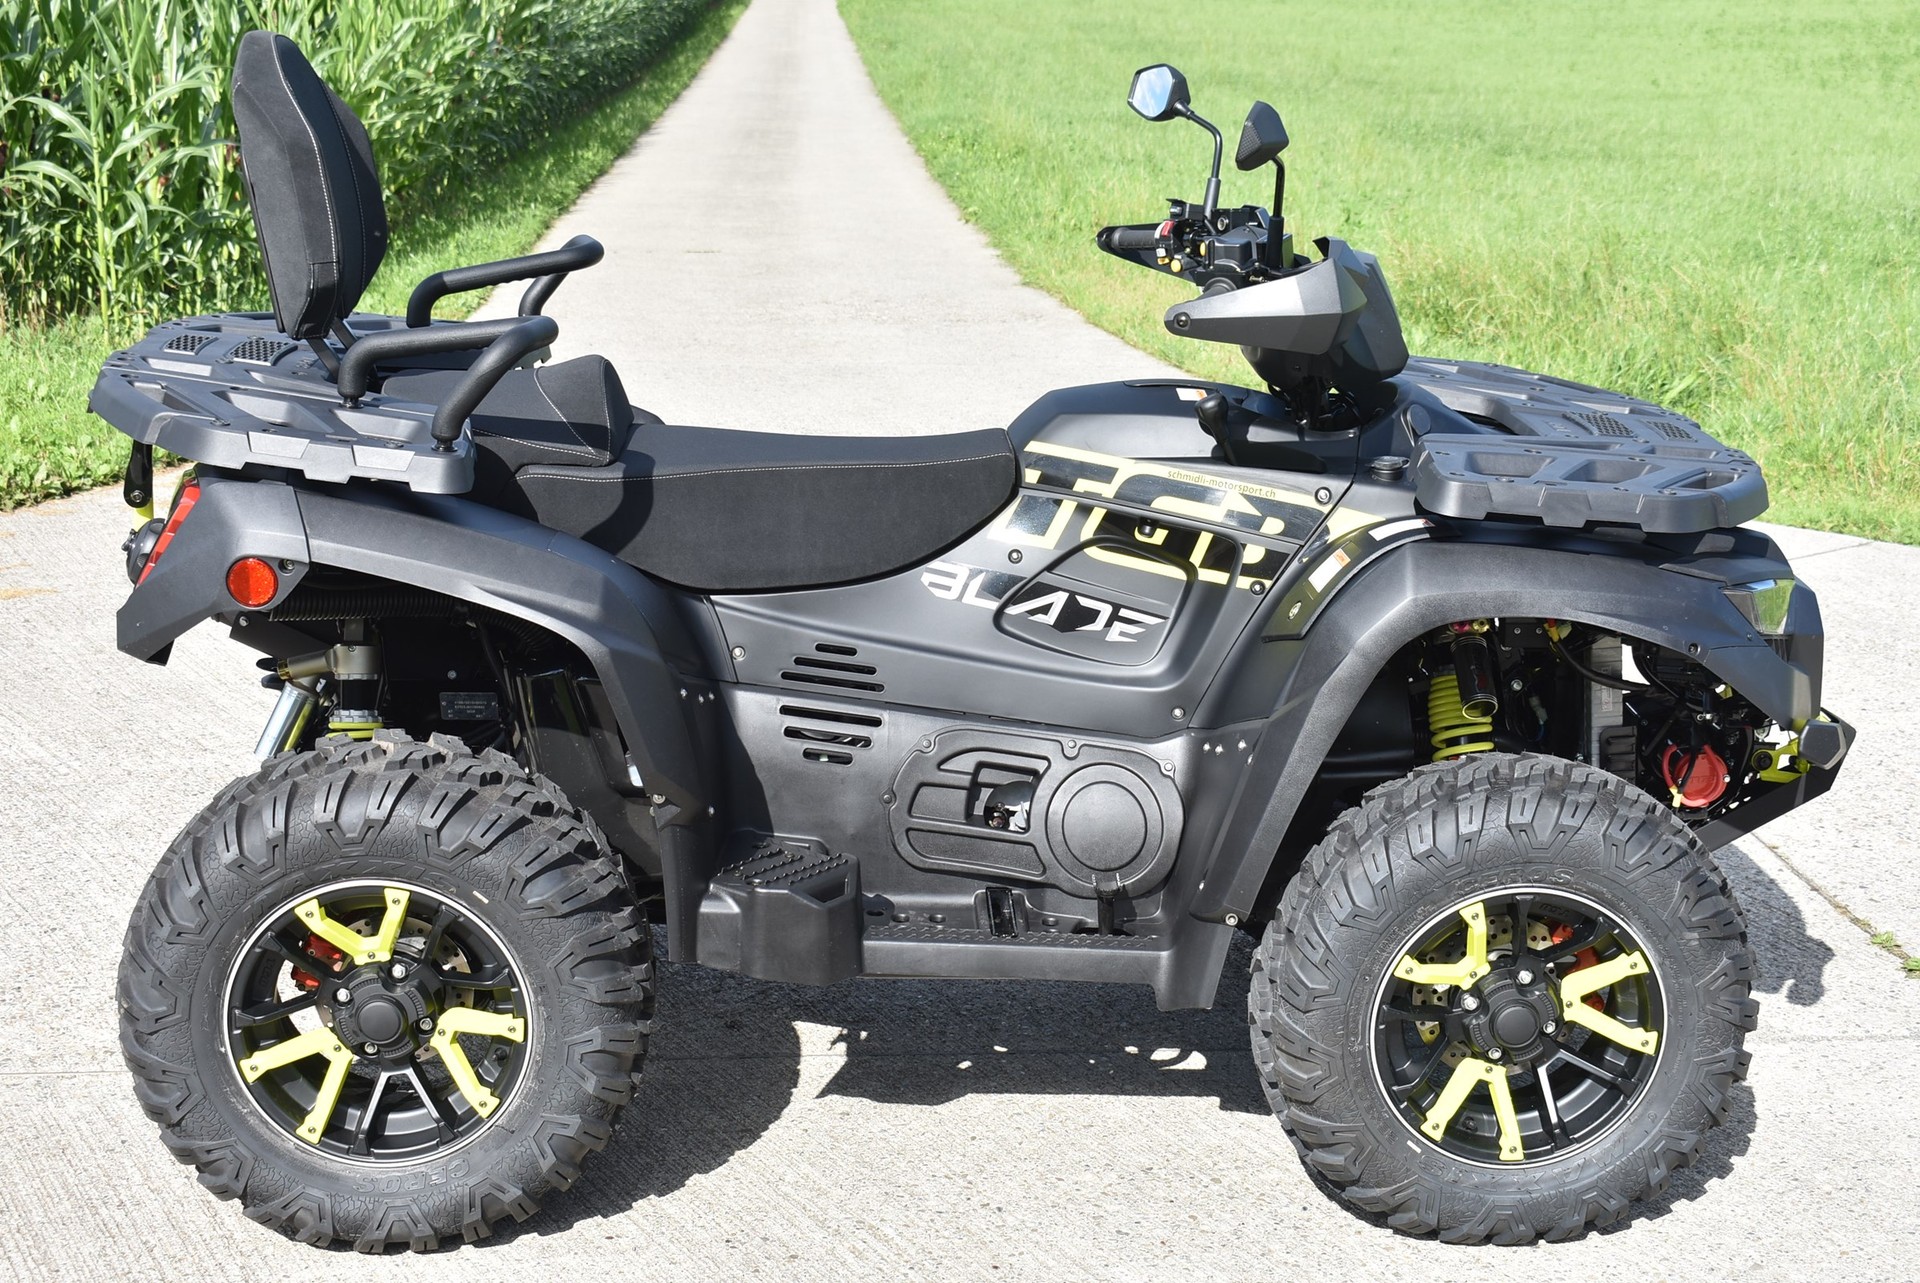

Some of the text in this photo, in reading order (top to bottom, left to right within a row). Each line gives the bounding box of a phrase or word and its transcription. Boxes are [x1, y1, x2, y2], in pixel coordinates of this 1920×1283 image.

[1167, 469, 1277, 498] schmidli-motorsport.ch
[920, 561, 1169, 643] BLADE
[352, 1157, 471, 1194] CEROS
